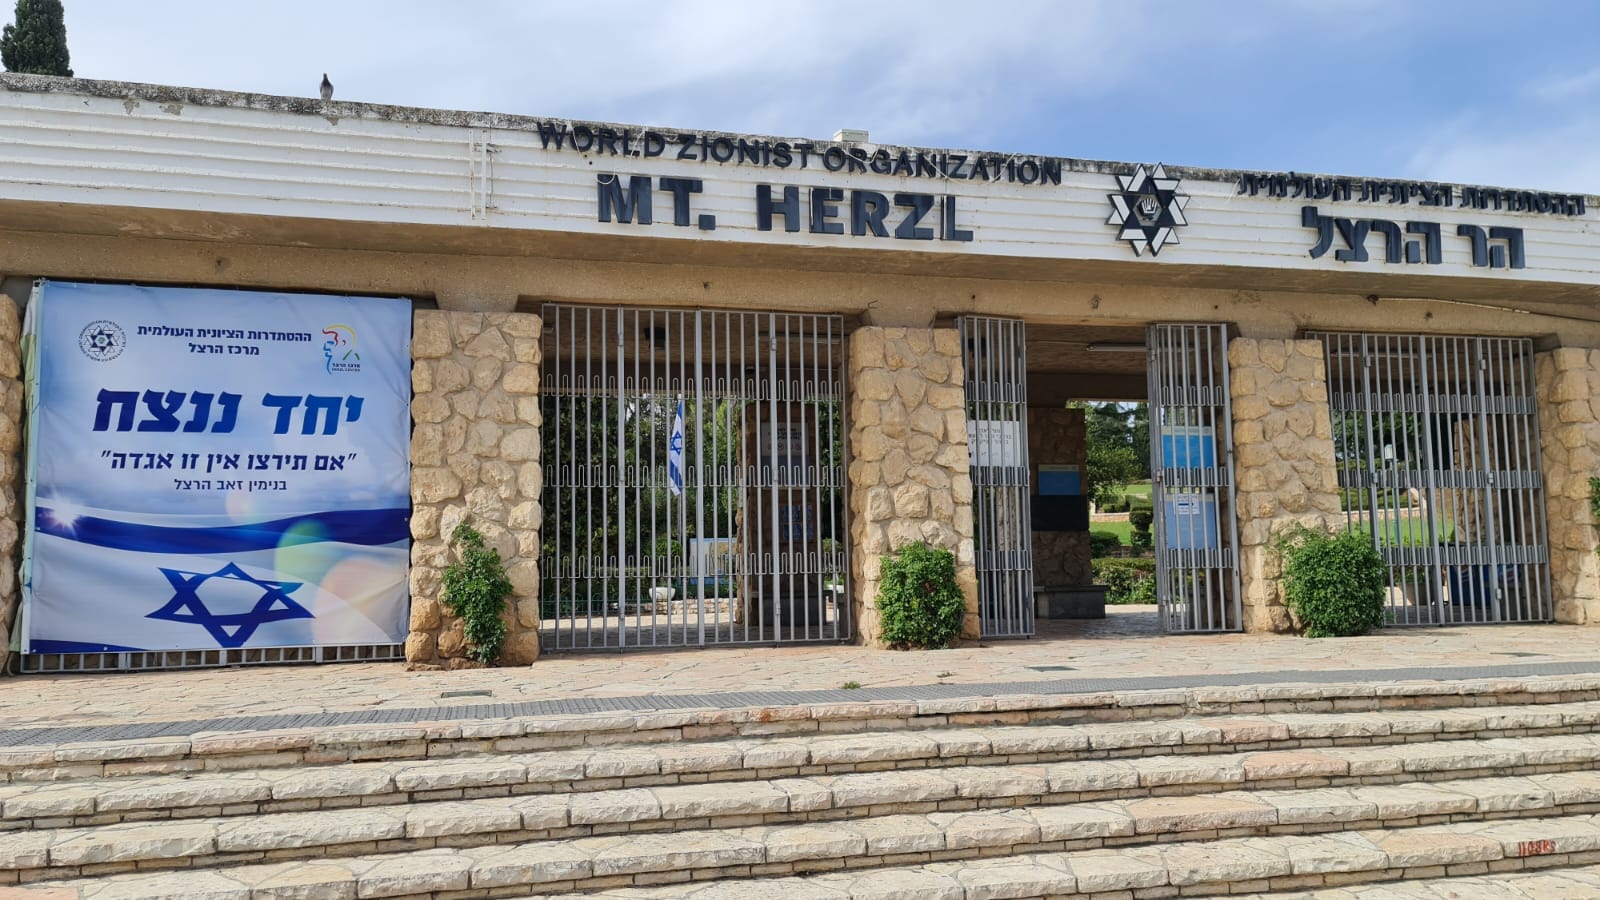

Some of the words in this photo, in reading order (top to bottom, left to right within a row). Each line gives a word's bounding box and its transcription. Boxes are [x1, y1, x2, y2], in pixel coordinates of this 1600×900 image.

[537, 121, 666, 158] WORLD
[677, 133, 814, 169] ZIONIST
[823, 146, 1062, 186] ORGANIZATION
[1237, 171, 1351, 201] העולמית
[1358, 180, 1453, 207] הציונית
[597, 173, 716, 230] MT.
[756, 184, 974, 241] HERZL
[1460, 187, 1586, 216] ההסתדרות
[1301, 206, 1442, 264] הרצל
[1457, 224, 1526, 269] הר
[137, 325, 194, 337] העולמית
[196, 328, 244, 339] הציונית
[247, 330, 312, 342] ההסתדרות
[188, 342, 224, 354] הרצל
[228, 345, 260, 355] מרכז
[92, 388, 242, 433] ננצח
[262, 392, 365, 435] יחד
[181, 453, 200, 470] זו
[206, 453, 240, 473] אין
[247, 454, 308, 471] תירצו
[174, 478, 211, 490] הרצל
[216, 479, 243, 491] זאב
[248, 480, 287, 492] בנימין
